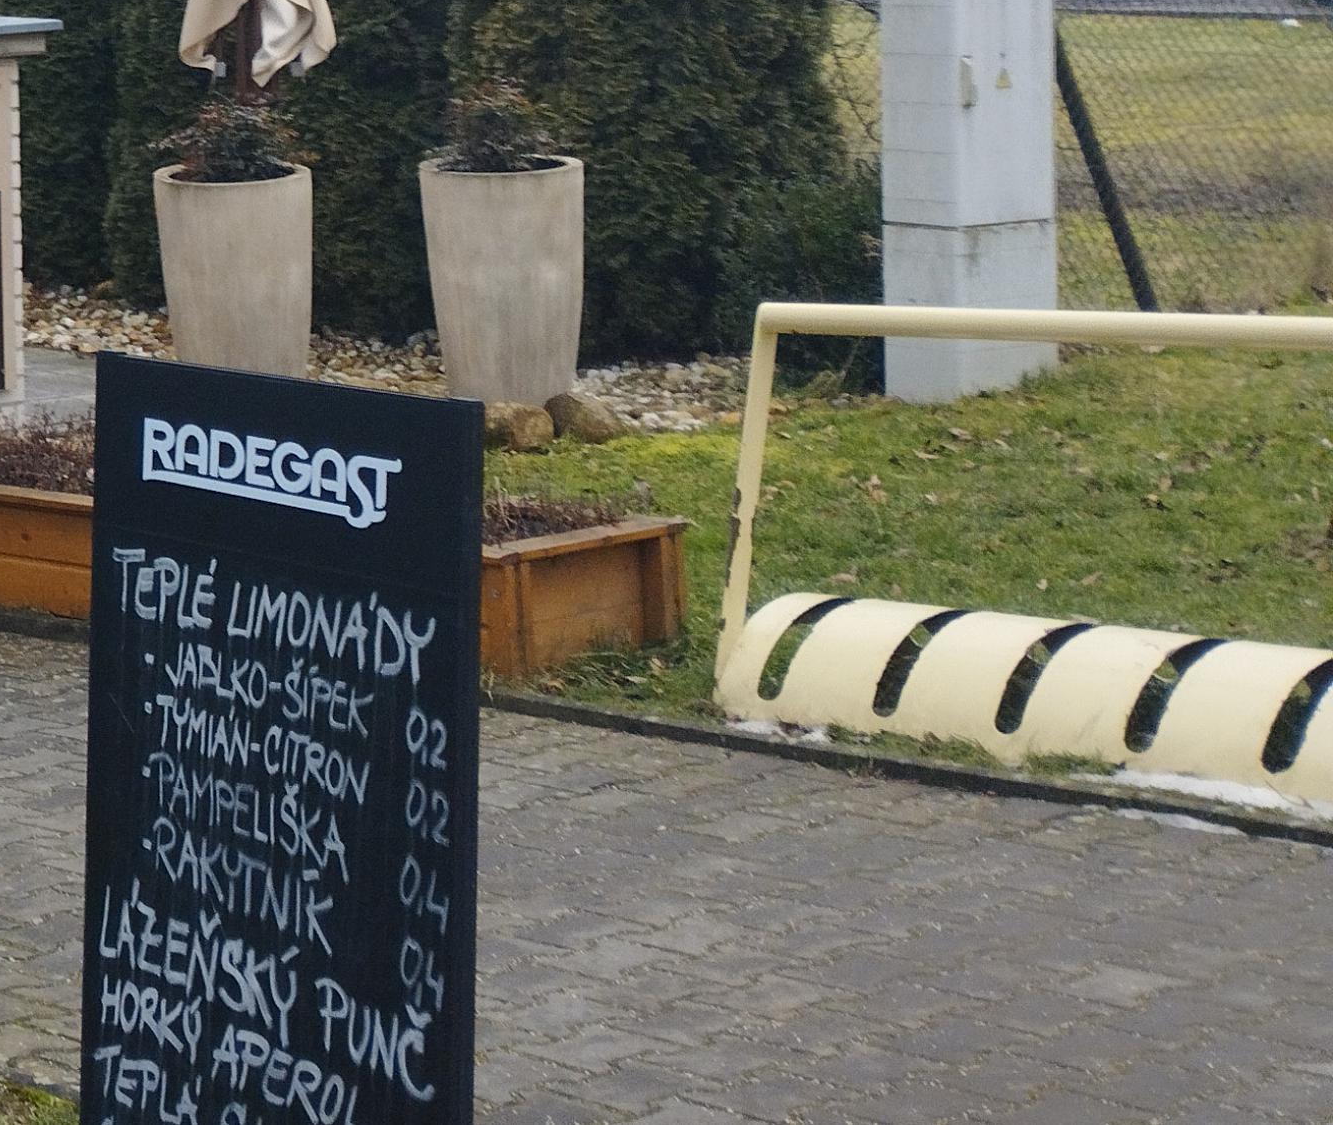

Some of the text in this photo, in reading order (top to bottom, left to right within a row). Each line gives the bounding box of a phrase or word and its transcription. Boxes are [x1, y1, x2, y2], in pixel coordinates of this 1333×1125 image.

[142, 417, 403, 529] RADEGAST
[113, 546, 436, 684] TEPLÉ LIMONÁDY
[406, 706, 448, 771] 0,2
[148, 751, 449, 935] PAMPELIŠKA 0,4
[405, 779, 451, 847] 0,2
[98, 877, 435, 1102] LÁZEŇSKÝ PUNČ
[399, 936, 445, 1012] 0,4
[100, 974, 358, 1125] HORKÝ APEROL
